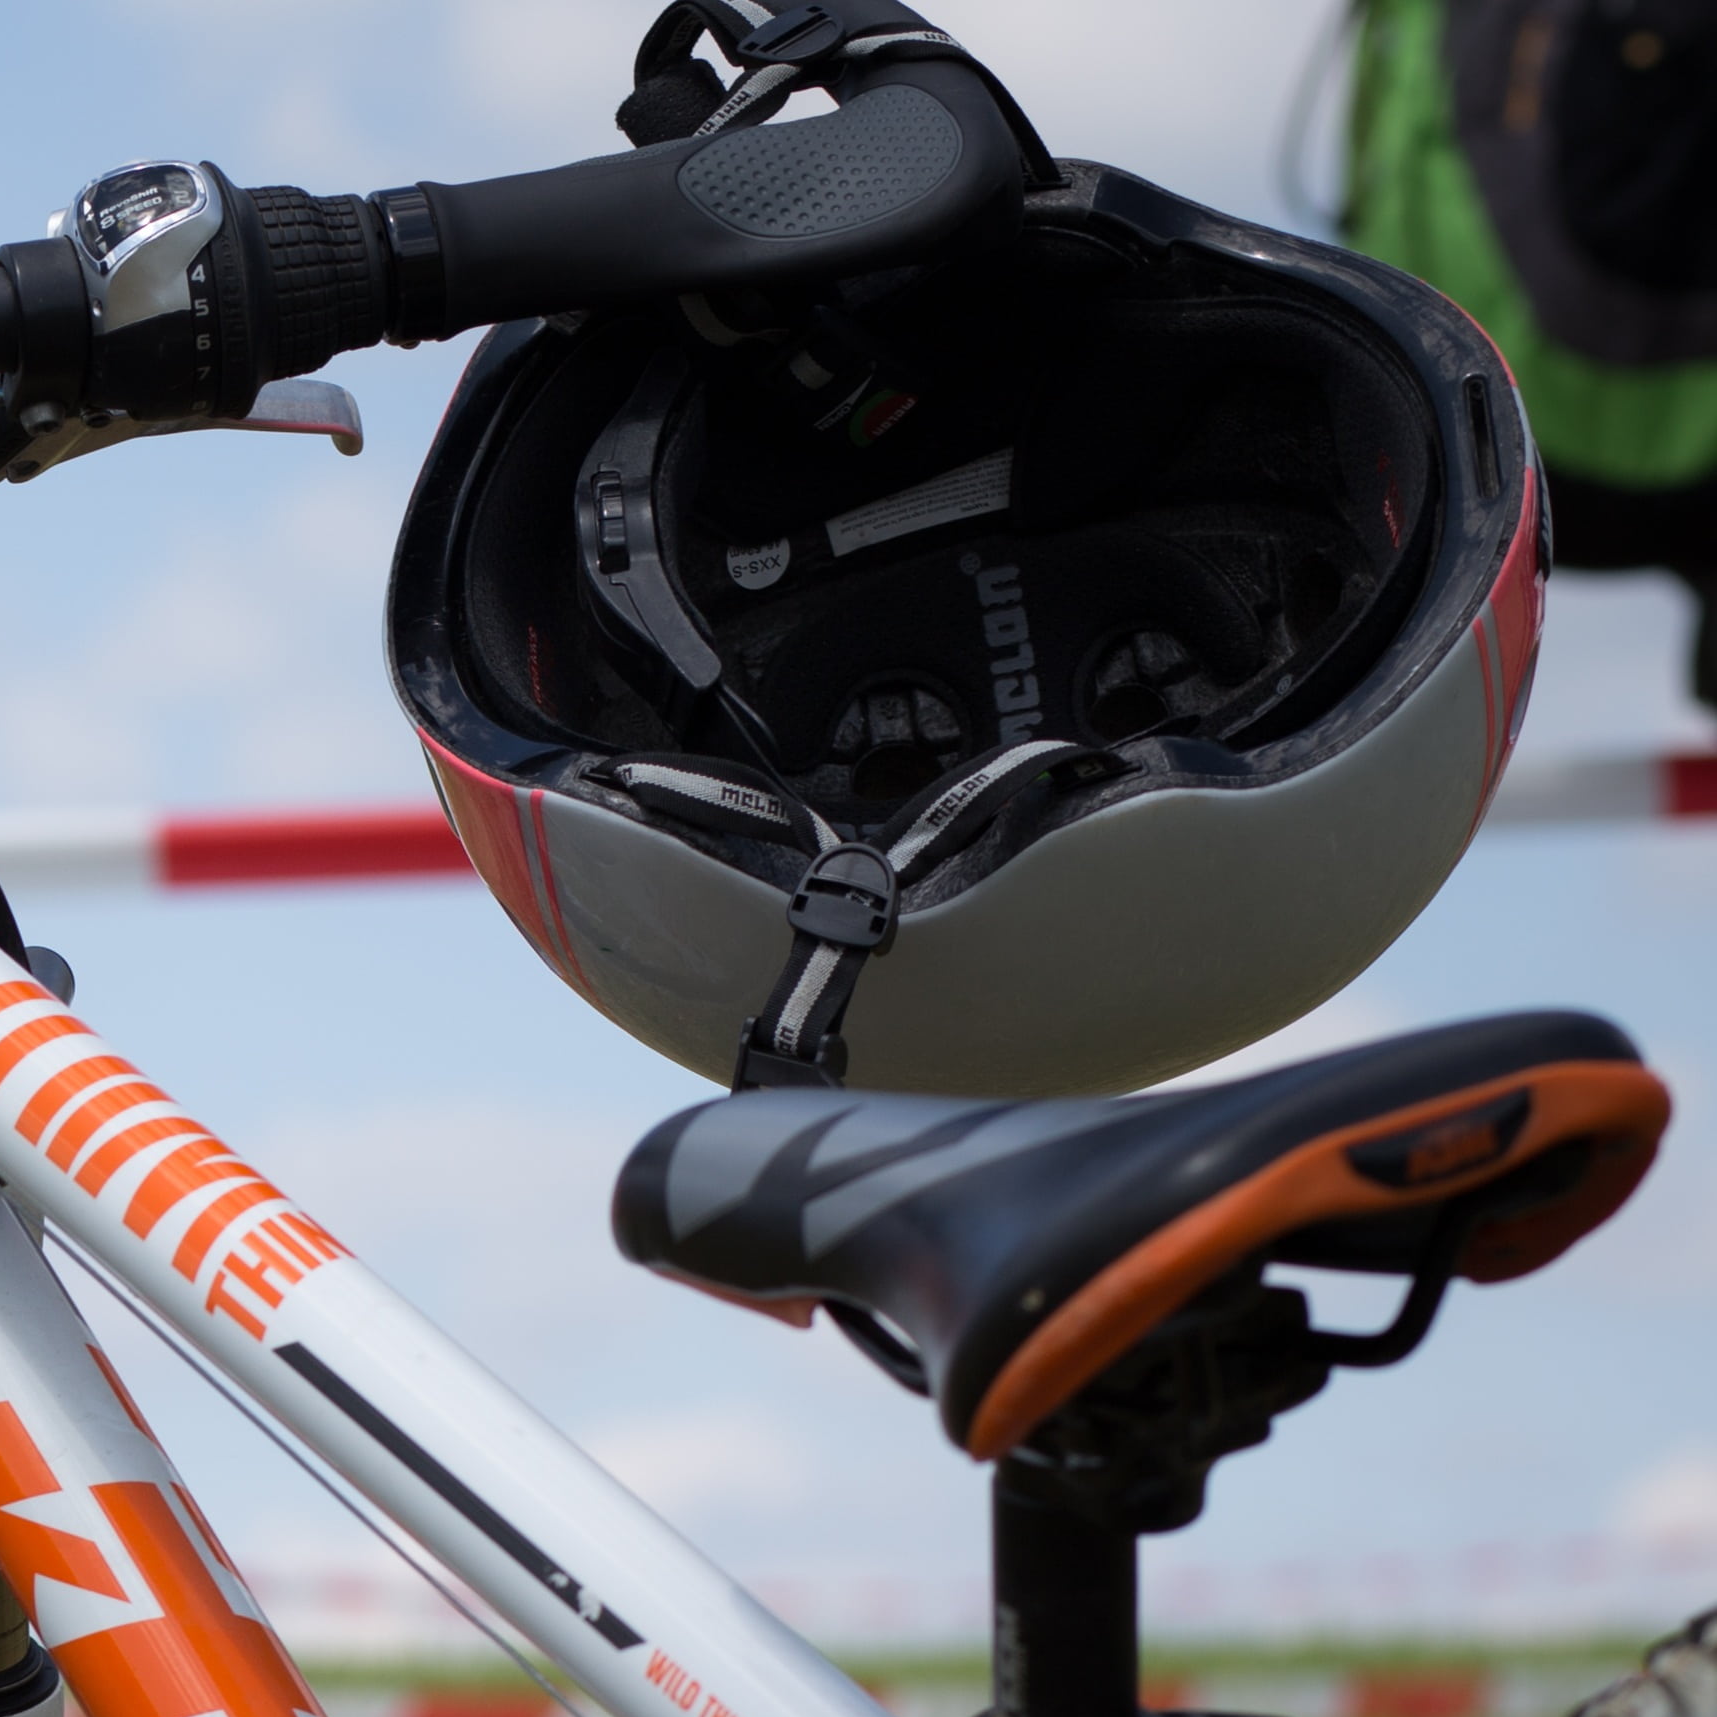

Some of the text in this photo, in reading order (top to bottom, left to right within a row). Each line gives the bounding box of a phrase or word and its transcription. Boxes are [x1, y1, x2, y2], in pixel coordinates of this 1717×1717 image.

[116, 196, 163, 220] SPEED
[190, 263, 207, 284] 4
[193, 298, 210, 318] 5
[196, 333, 212, 351] 6
[197, 366, 212, 382] 7
[731, 554, 781, 579] XXS-S
[204, 1212, 357, 1343] THIN
[642, 1647, 700, 1711] WILD
